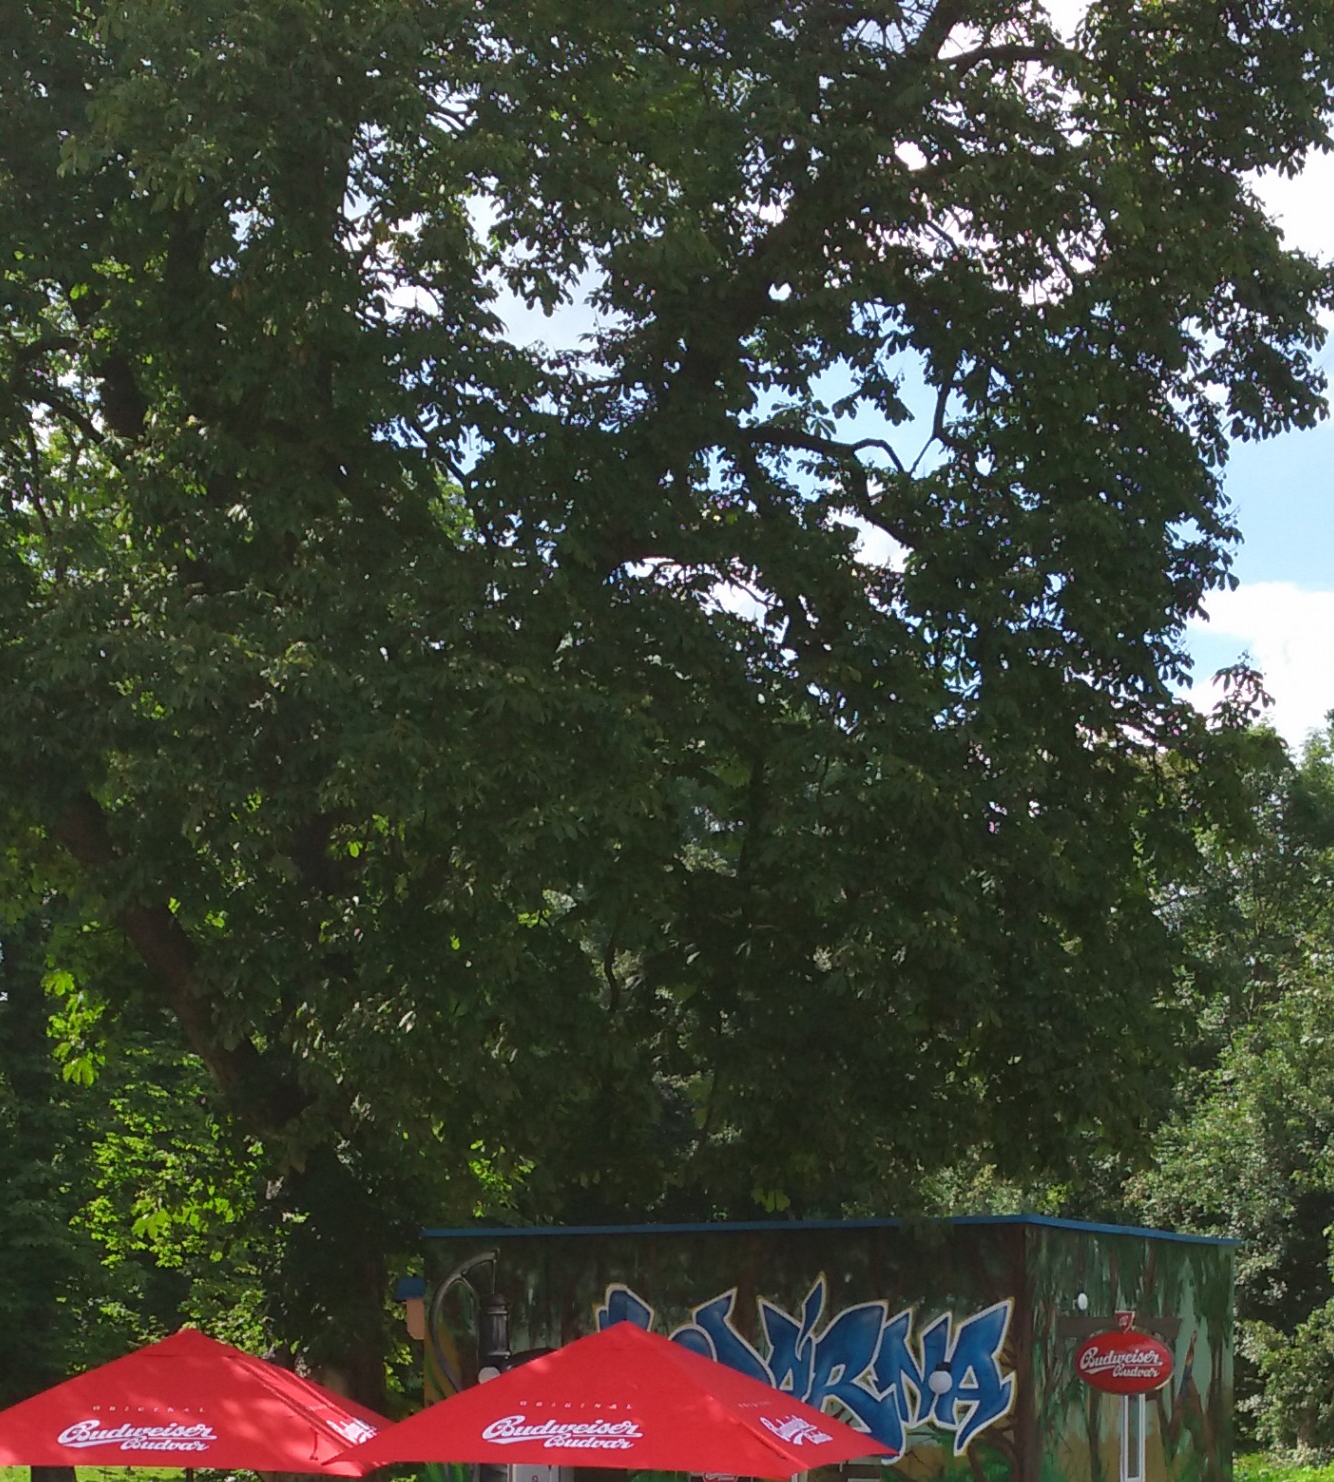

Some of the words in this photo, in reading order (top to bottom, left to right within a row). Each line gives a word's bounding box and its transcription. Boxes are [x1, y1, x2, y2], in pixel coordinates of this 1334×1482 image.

[1079, 1346, 1164, 1374] Budweiser
[1112, 1363, 1160, 1378] Budvar
[58, 1419, 217, 1448] Budweiser
[482, 1415, 644, 1444] Budweiser
[120, 1437, 210, 1451] Budvar
[543, 1433, 635, 1449] Budvar
